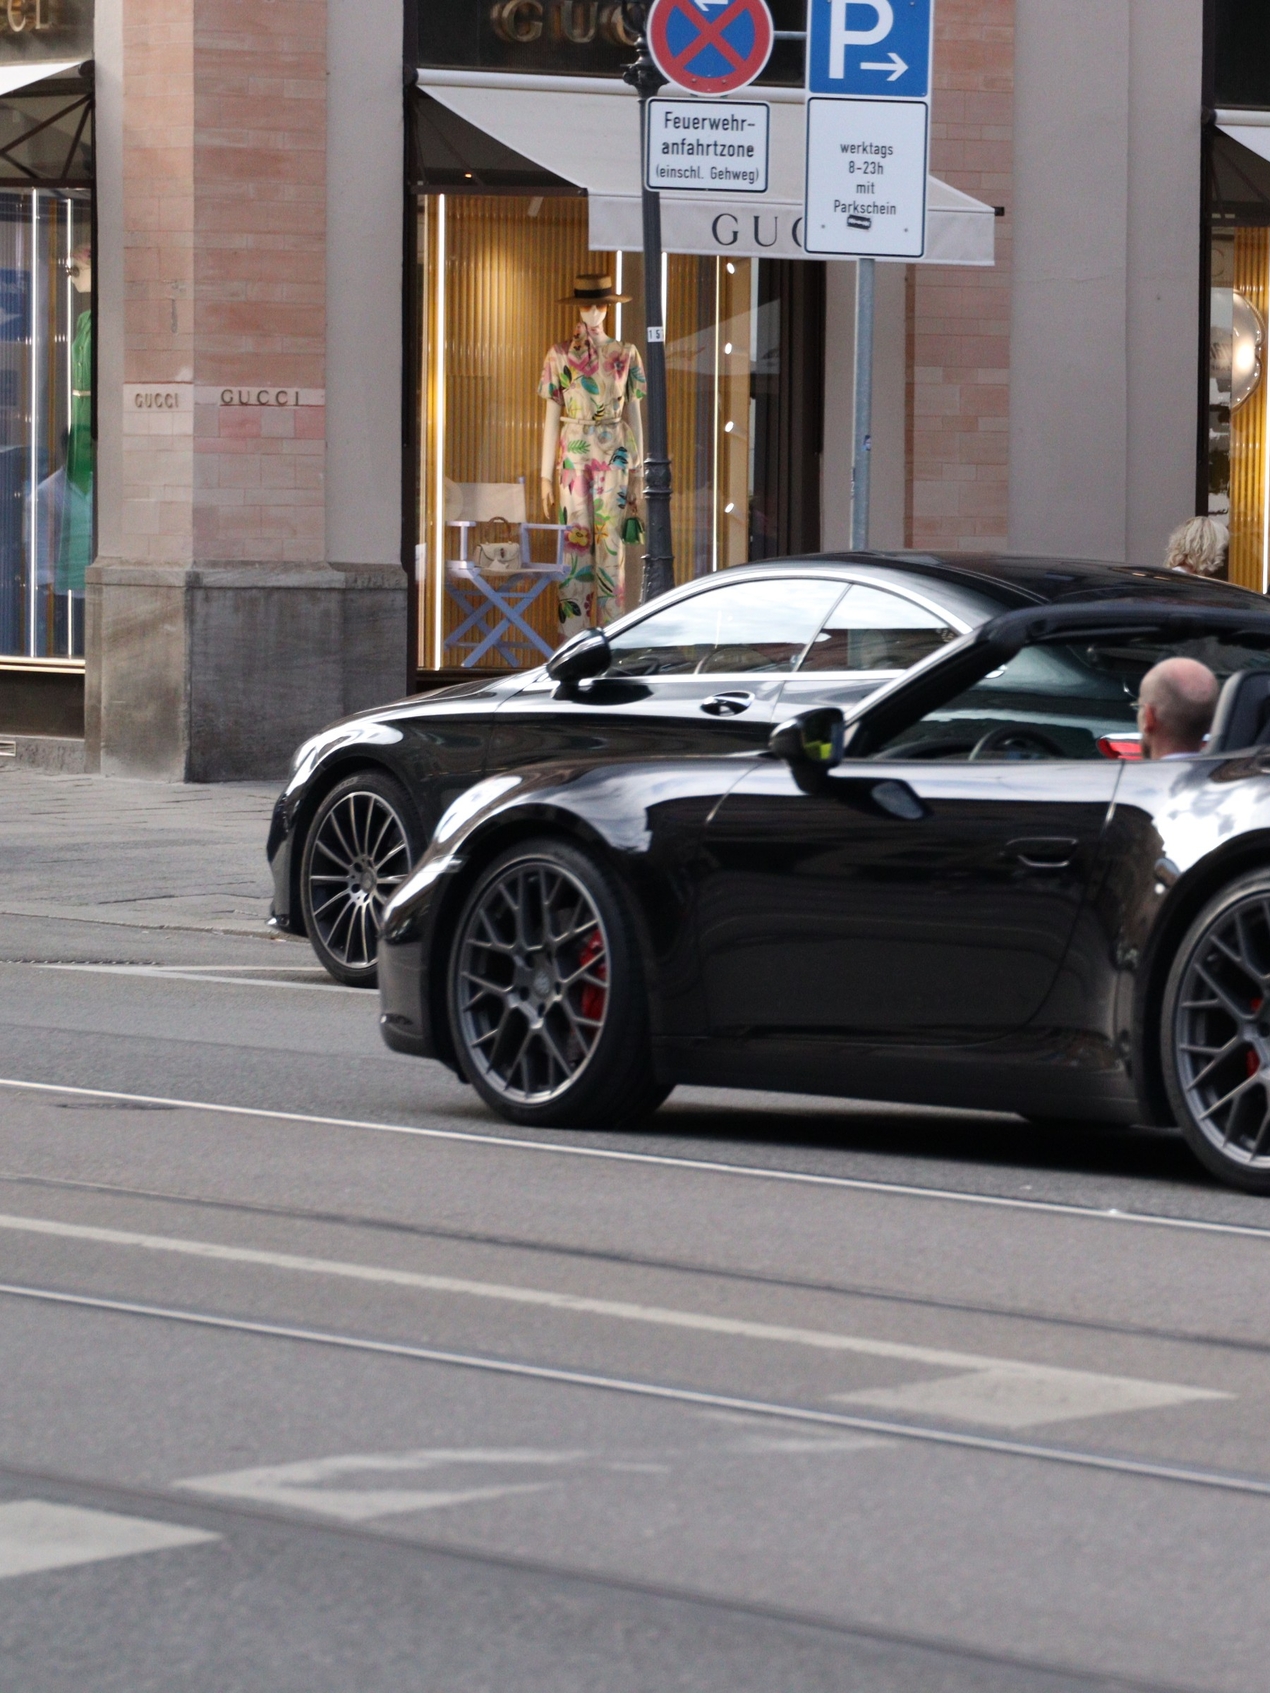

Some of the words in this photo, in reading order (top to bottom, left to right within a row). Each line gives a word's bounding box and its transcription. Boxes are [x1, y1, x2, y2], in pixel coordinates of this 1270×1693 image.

[829, 0, 894, 79] P
[664, 111, 756, 131] Feuerwehr-
[661, 138, 755, 158] anfahrtzone
[840, 142, 894, 159] werktags
[655, 164, 704, 179] (einschl.
[710, 166, 760, 184] Gehweg)
[848, 160, 884, 175] 8-23h
[856, 181, 875, 195] mit
[833, 200, 897, 215] Parkschein
[133, 392, 179, 409] GUCCI
[220, 388, 299, 407] GUCCI
